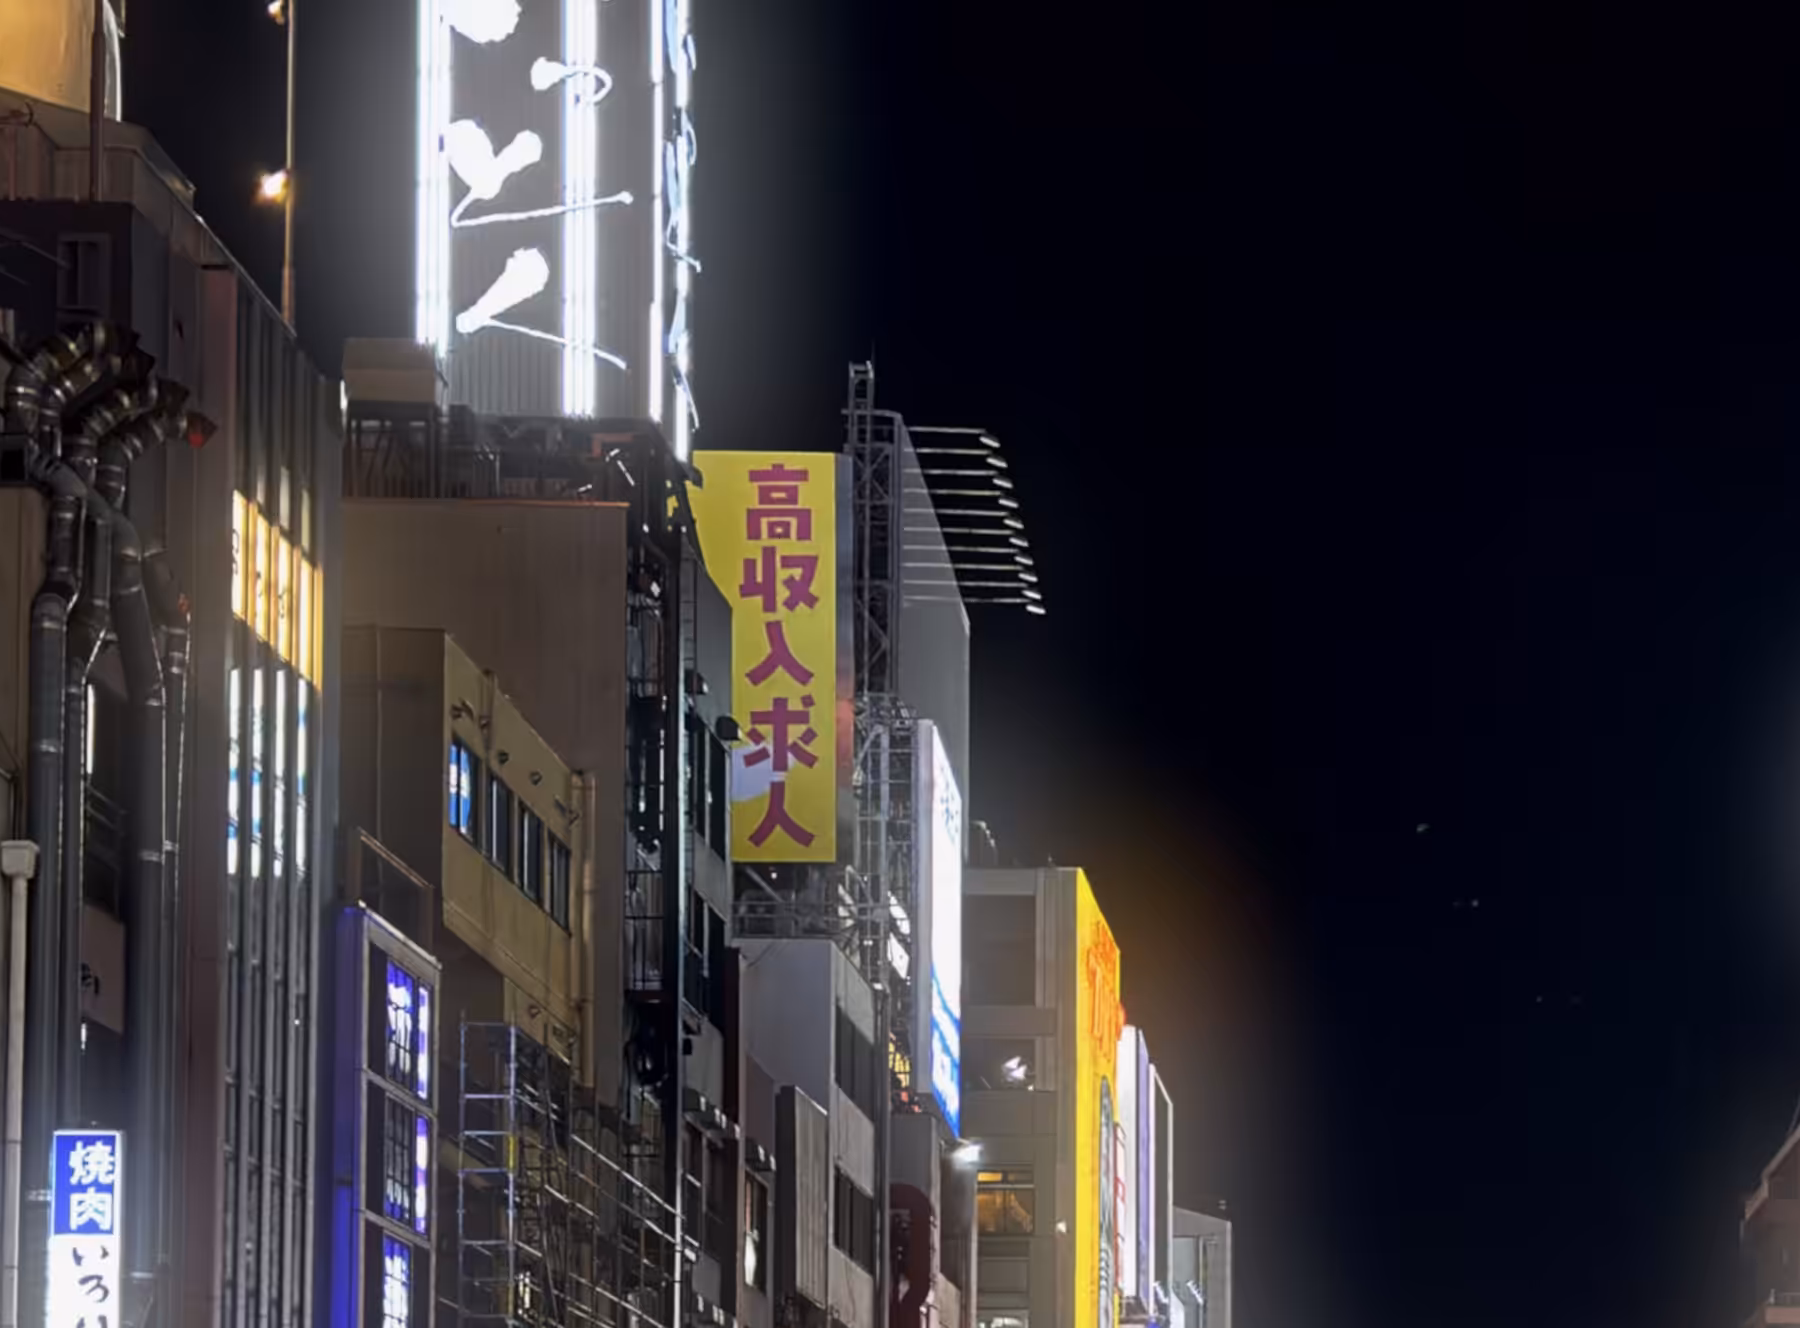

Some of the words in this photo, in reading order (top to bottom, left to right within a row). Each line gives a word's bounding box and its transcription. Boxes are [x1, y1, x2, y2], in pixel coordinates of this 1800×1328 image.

[738, 461, 819, 849] 高収入求人
[68, 1139, 116, 1231] 焼肉
